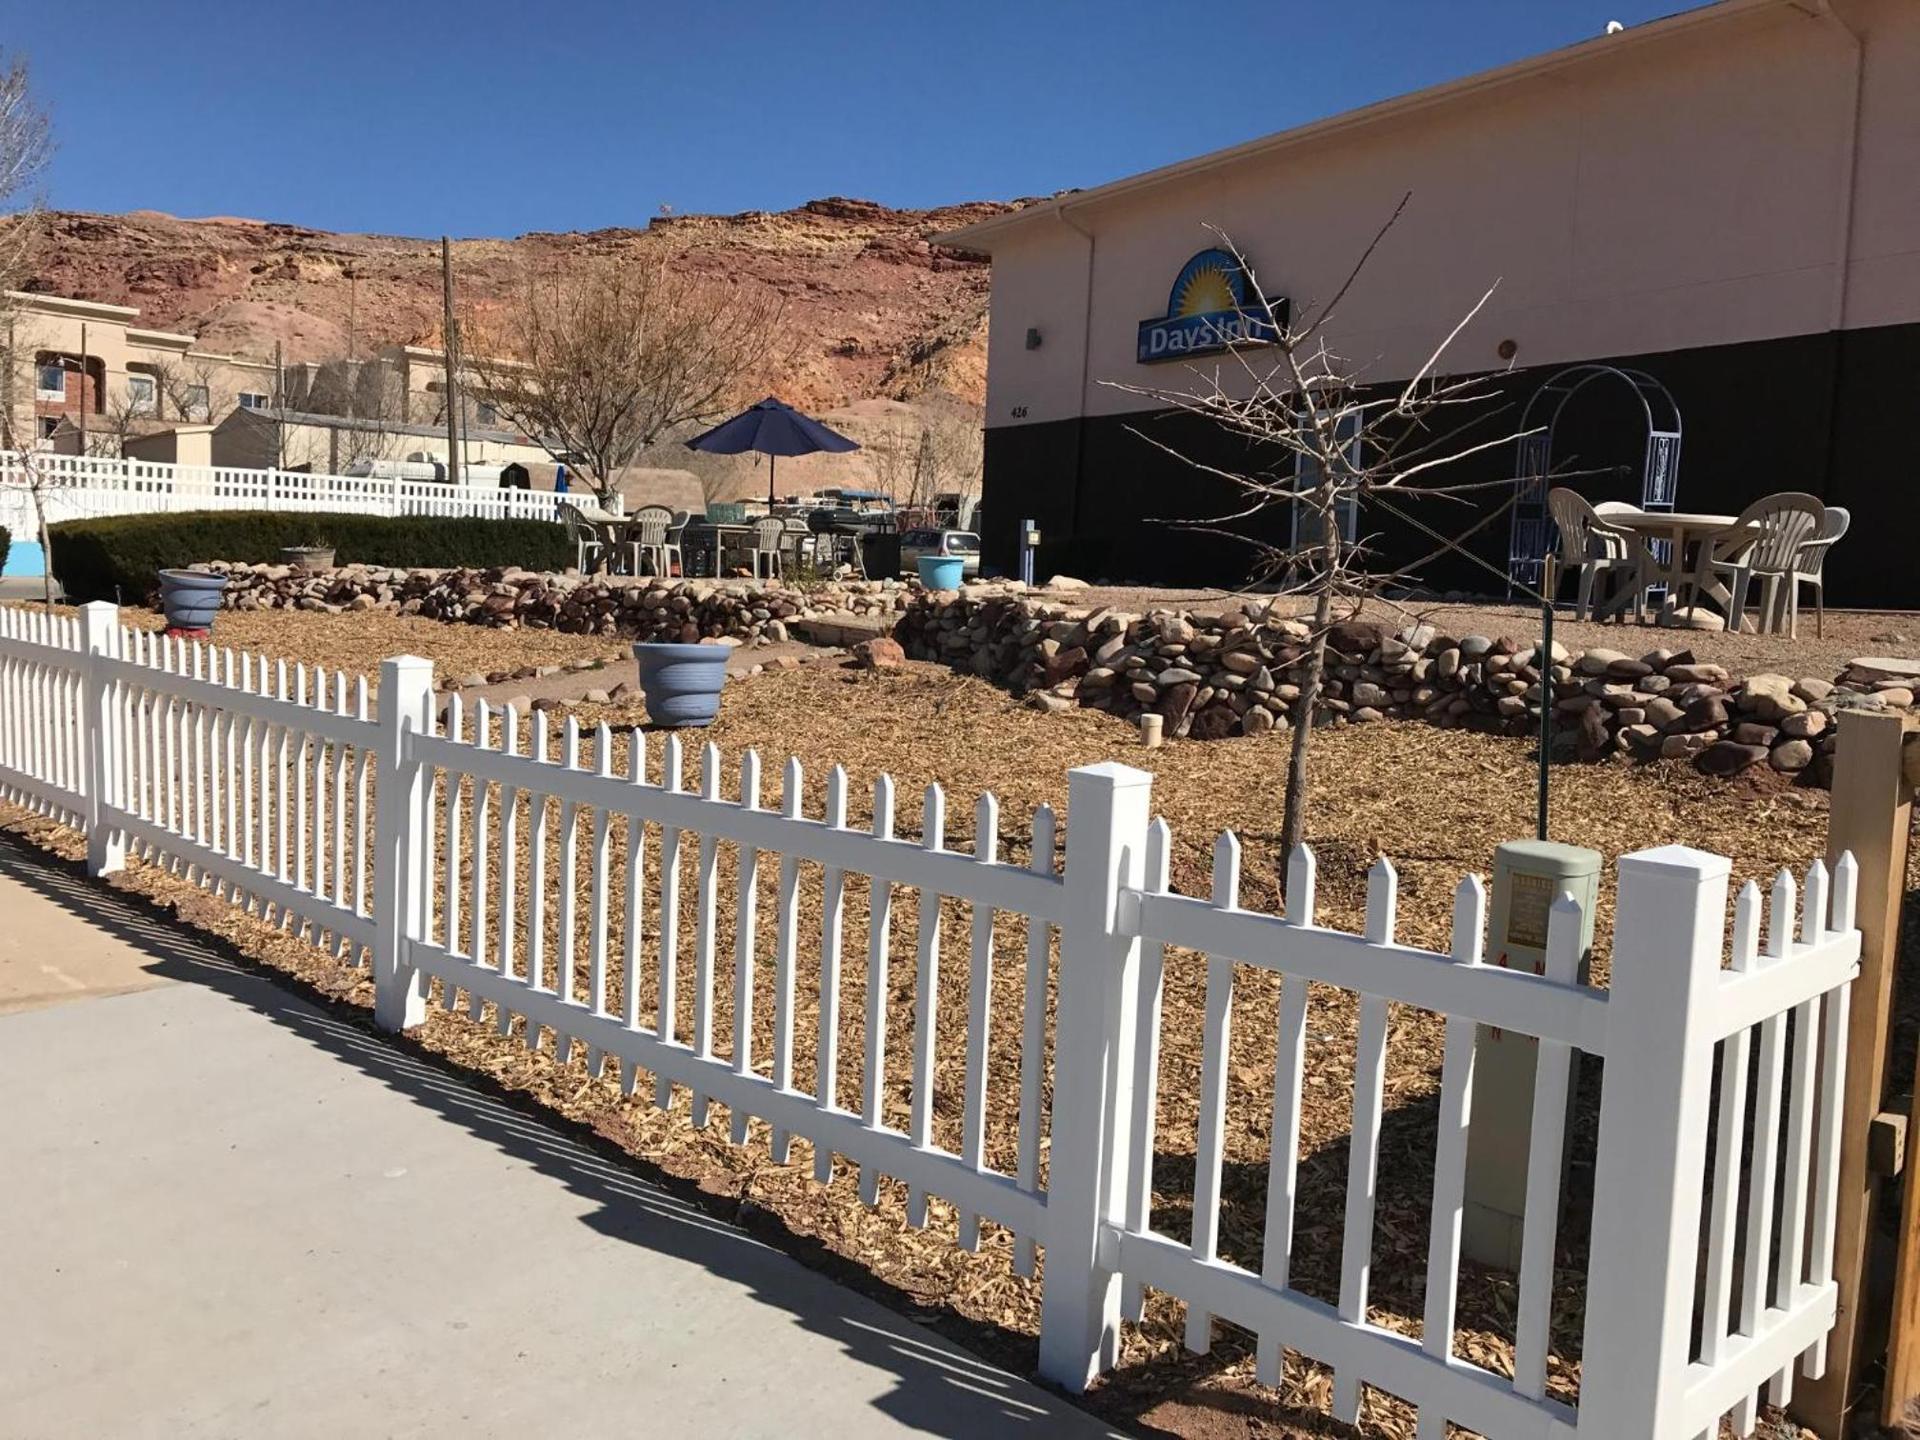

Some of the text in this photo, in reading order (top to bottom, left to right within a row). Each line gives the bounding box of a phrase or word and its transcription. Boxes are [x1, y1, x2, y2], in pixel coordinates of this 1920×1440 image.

[1150, 317, 1262, 353] Days Inn
[1011, 406, 1029, 419] 426
